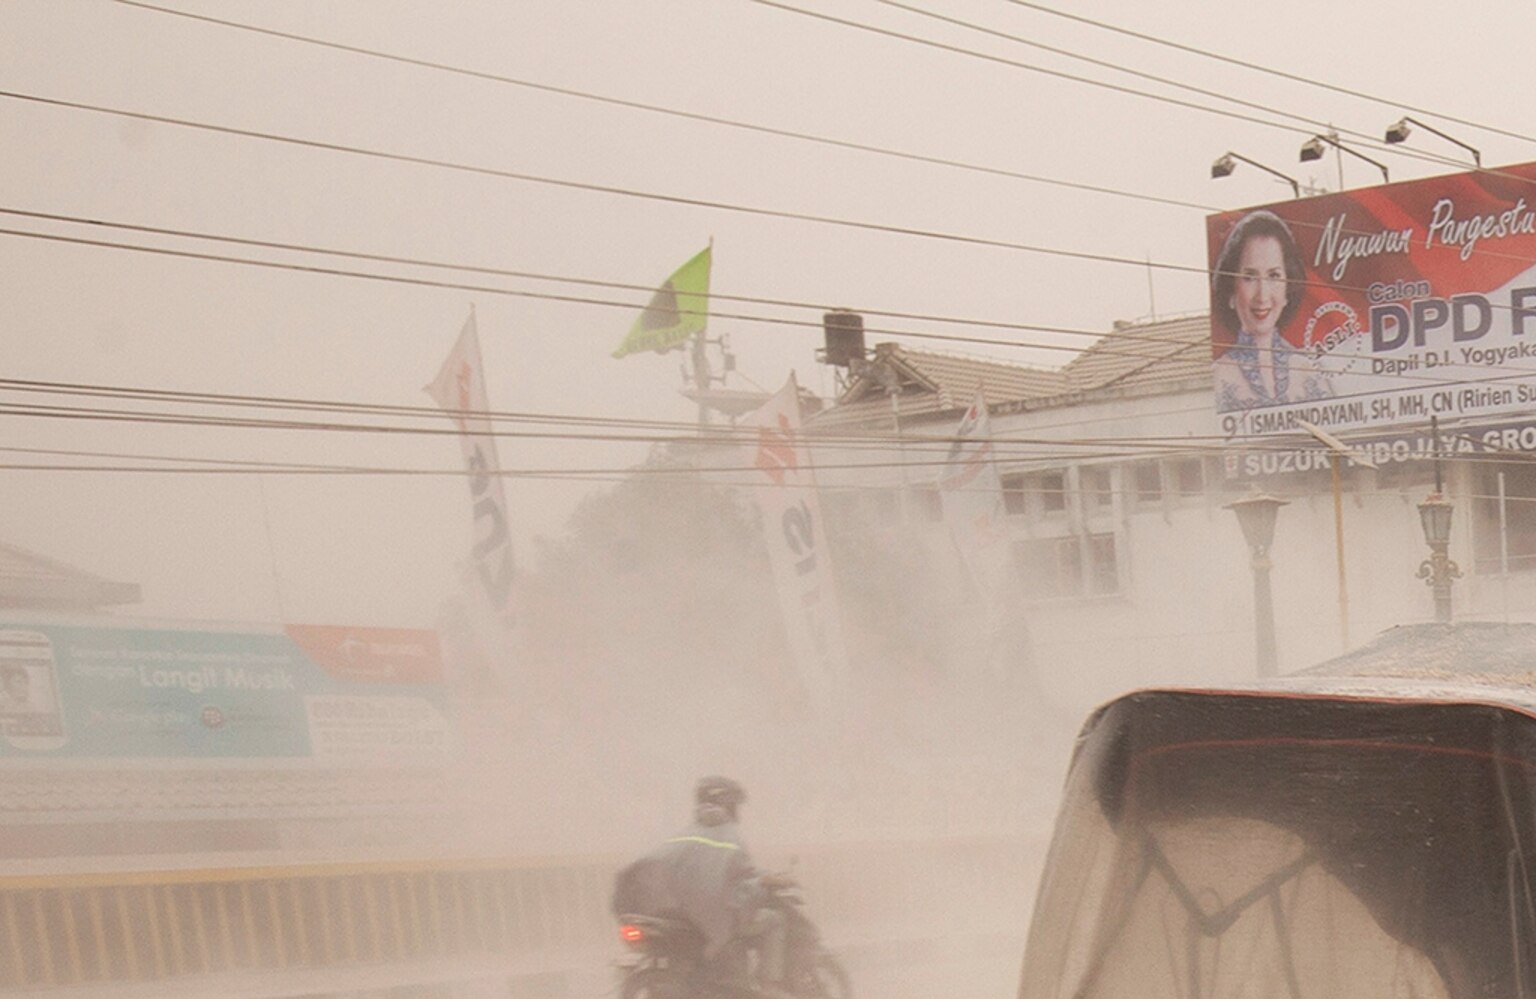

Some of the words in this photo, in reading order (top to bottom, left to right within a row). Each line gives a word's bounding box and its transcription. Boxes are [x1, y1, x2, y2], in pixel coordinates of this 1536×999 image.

[1368, 280, 1430, 303] Calon
[1369, 293, 1492, 353] DPD
[1313, 320, 1355, 360] ASLI
[1372, 353, 1419, 376] Dapil
[1371, 398, 1395, 420] SH,
[1400, 394, 1428, 417] MH,
[1432, 391, 1453, 413] CN
[1457, 387, 1512, 413] (Ririen
[1244, 451, 1332, 476] SUZUK
[139, 664, 217, 694] Langit
[226, 667, 295, 690] Musik
